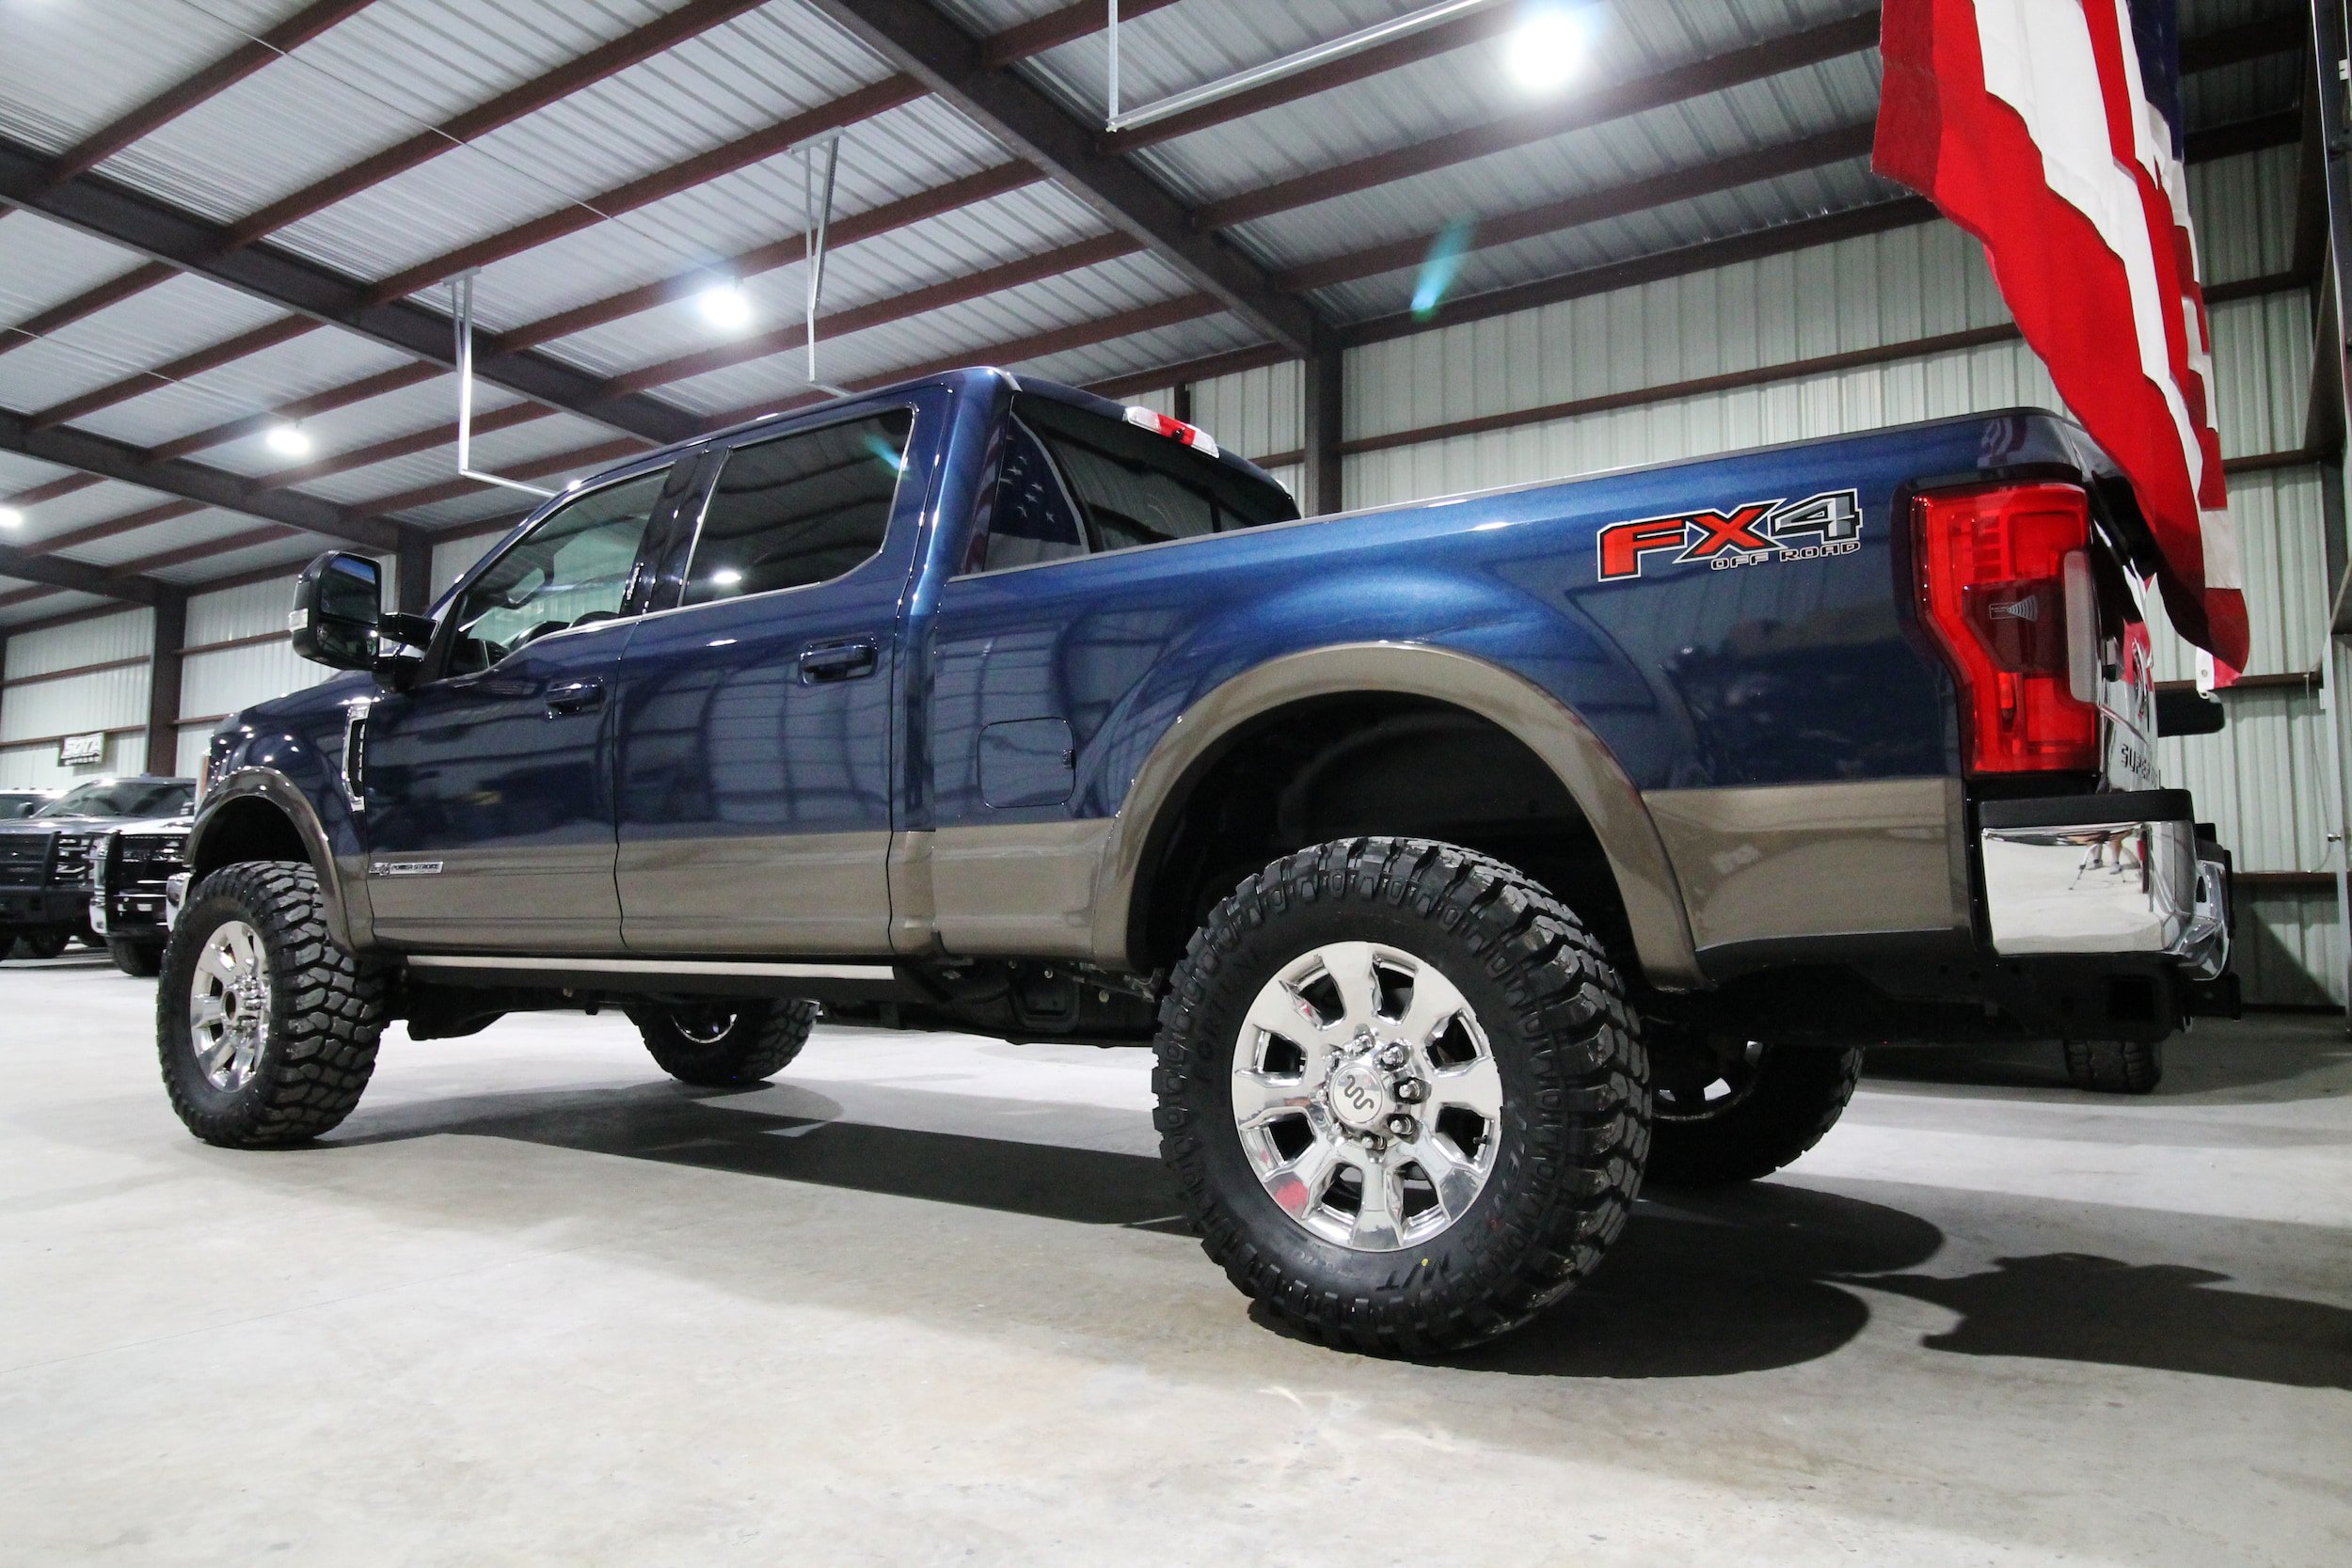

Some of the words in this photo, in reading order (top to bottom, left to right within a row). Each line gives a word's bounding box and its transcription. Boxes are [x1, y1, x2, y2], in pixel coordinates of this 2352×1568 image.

[1597, 488, 1863, 582] FX4
[1710, 552, 1770, 570] OFF
[1779, 542, 1861, 562] ROAD
